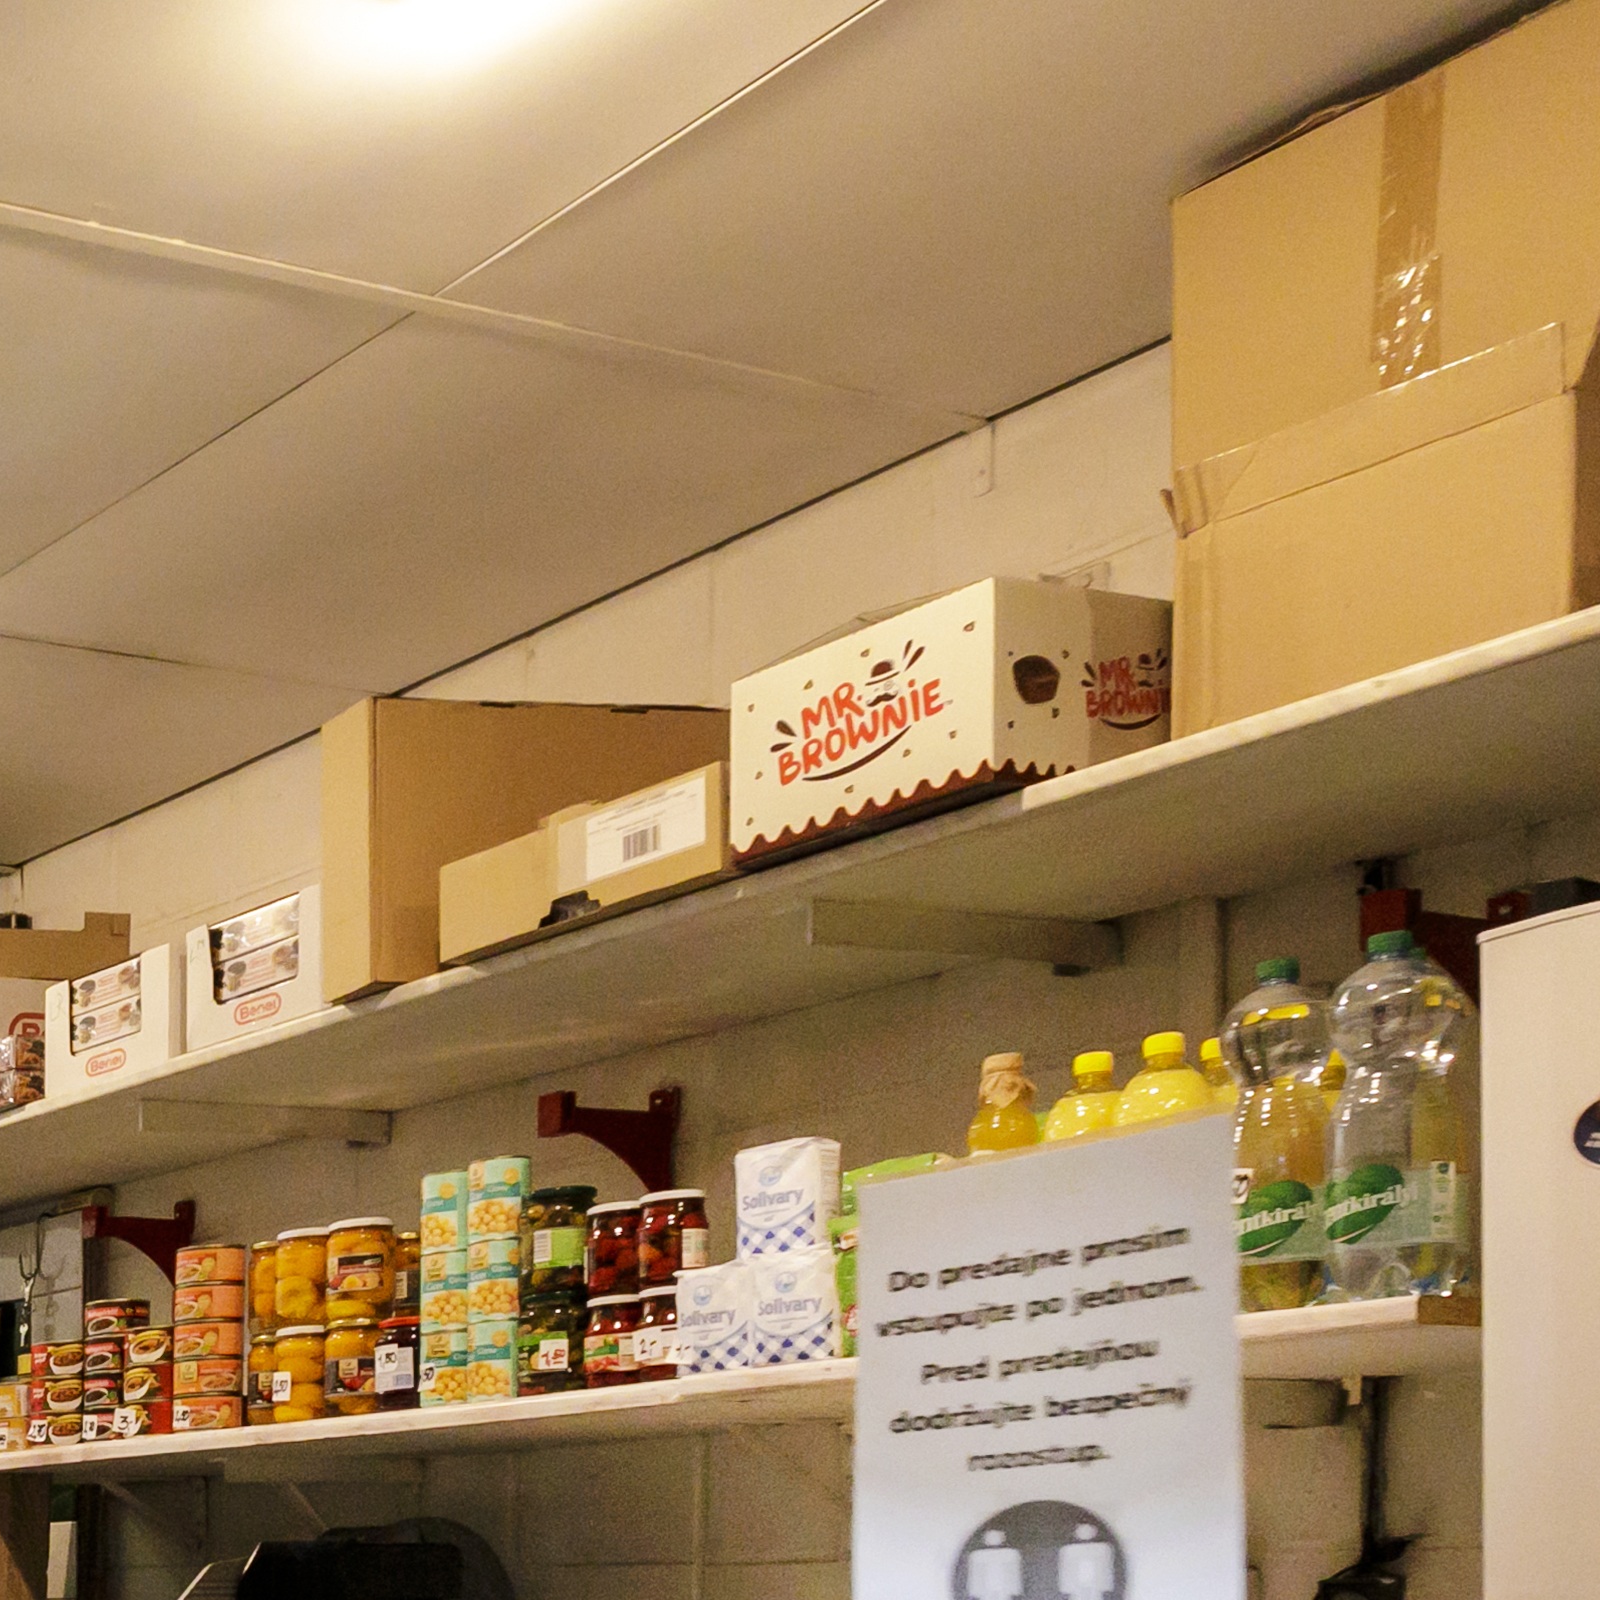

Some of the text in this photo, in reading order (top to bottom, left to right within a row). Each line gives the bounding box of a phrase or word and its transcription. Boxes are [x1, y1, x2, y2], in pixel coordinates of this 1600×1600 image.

[802, 682, 865, 737] MR.
[777, 677, 946, 786] BROWNIE
[742, 1188, 805, 1212] Solivary
[888, 1270, 931, 1292] Do
[680, 1308, 736, 1328] Solivary
[758, 1296, 823, 1317] Solivary
[920, 1355, 990, 1385] Pred
